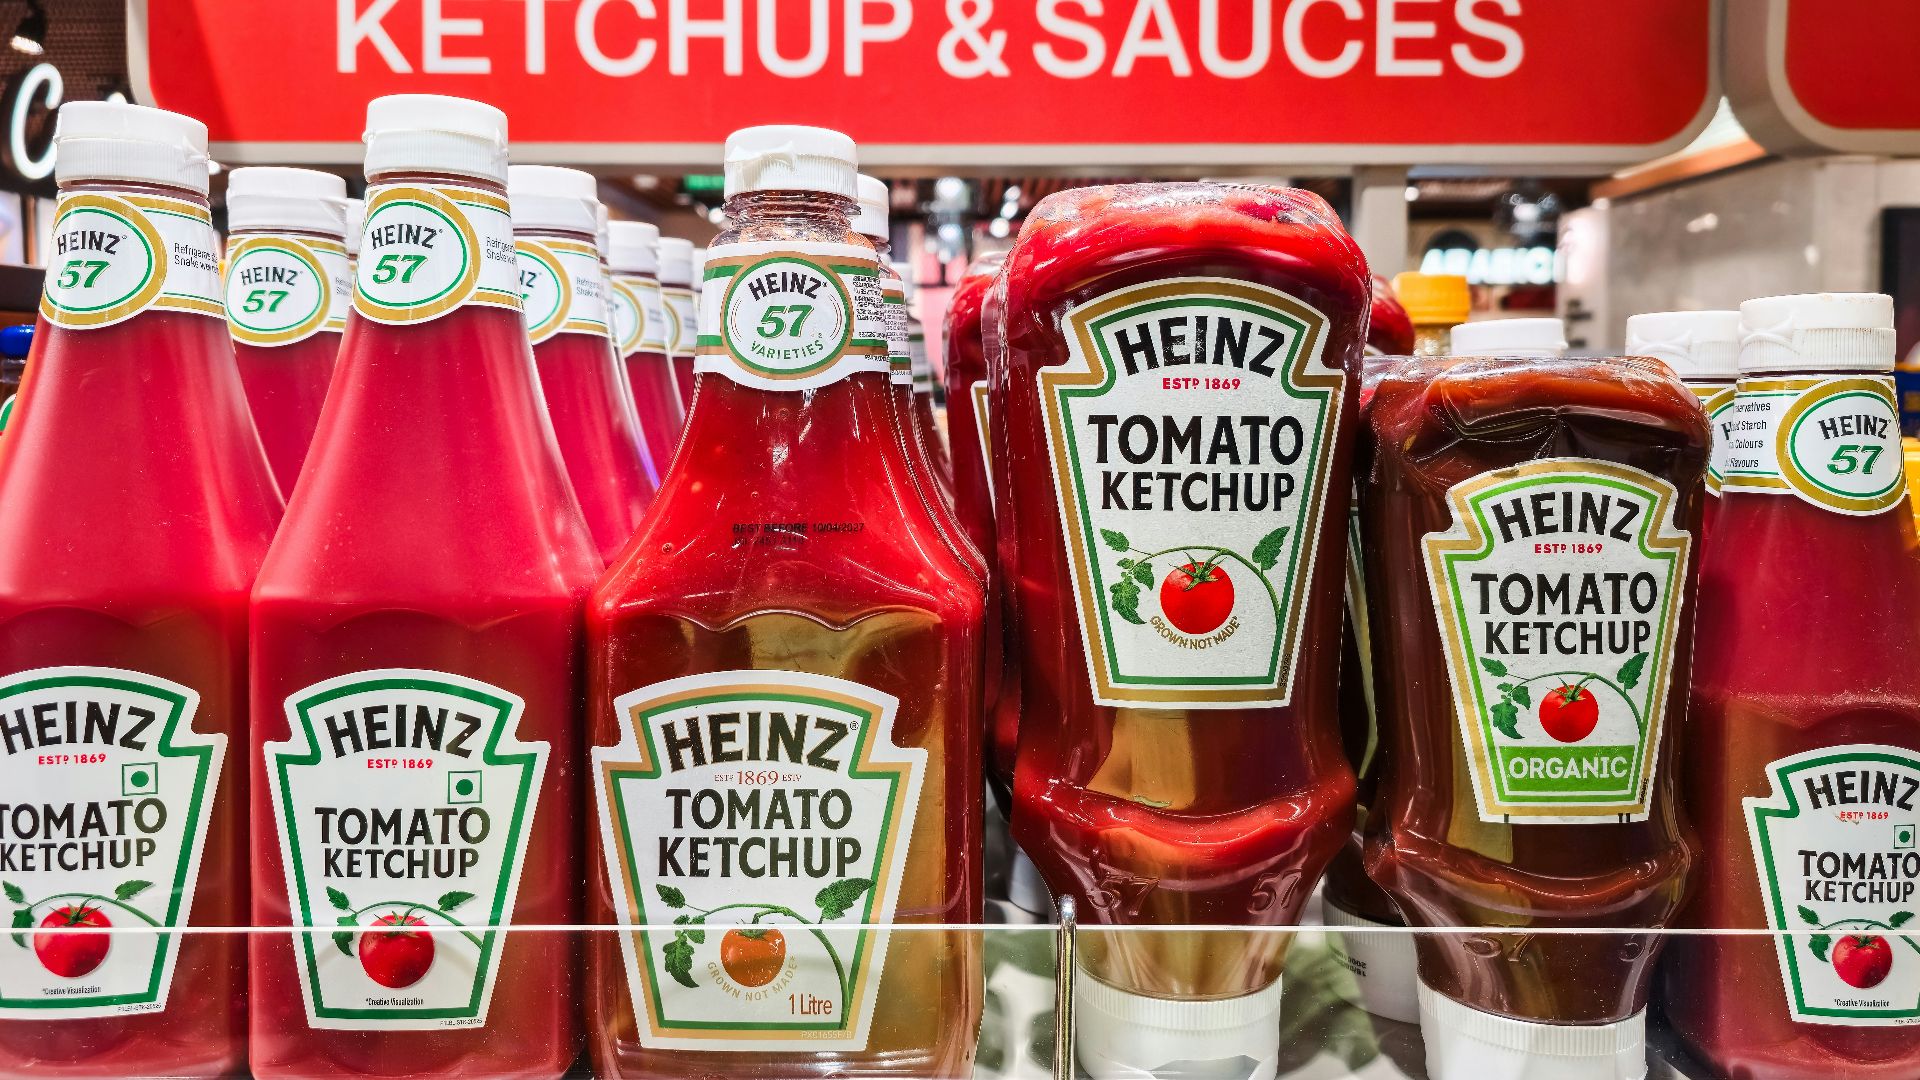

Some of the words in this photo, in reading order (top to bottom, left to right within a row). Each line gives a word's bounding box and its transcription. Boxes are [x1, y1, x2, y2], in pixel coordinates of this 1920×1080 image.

[336, 0, 913, 77] KETCHUP
[937, 0, 1010, 78] &
[1032, 0, 1523, 78] SAUCES
[57, 259, 111, 290] 57
[372, 254, 428, 285] 57
[242, 290, 289, 313] 57
[756, 304, 815, 339] 57
[751, 339, 824, 360] VARIETIES
[1114, 315, 1285, 378] HEINZ
[1205, 377, 1241, 390] 1869
[1087, 414, 1304, 466] TOMATO
[1826, 444, 1884, 475] 57
[1101, 470, 1295, 512] KETCHUP
[1491, 491, 1640, 544] HEINZ
[1572, 543, 1603, 554] 1869
[1470, 571, 1658, 616] TOMATO
[1149, 615, 1188, 649] GROWN
[1189, 637, 1213, 650] NOT
[1485, 620, 1651, 655] KETCHUP
[0, 700, 156, 756] HEINZ
[324, 704, 482, 759] HEINZ
[73, 753, 107, 764] 1869
[402, 759, 434, 769] 1869
[1508, 756, 1628, 779] ORGANIC
[737, 770, 779, 786] 1869
[1803, 770, 1920, 811] HEINZ
[315, 806, 491, 845] TOMATO
[665, 788, 853, 830] TOMATO
[1866, 811, 1889, 820] 1869
[324, 848, 479, 879] KETCHUP
[658, 836, 862, 878] KETCHUP
[1797, 850, 1920, 879] TOMATO
[1805, 879, 1915, 903] KETCHUP
[707, 961, 740, 999] GROWN
[745, 991, 769, 1001] NOT
[788, 994, 795, 1015] 1
[800, 994, 833, 1015] Litre
